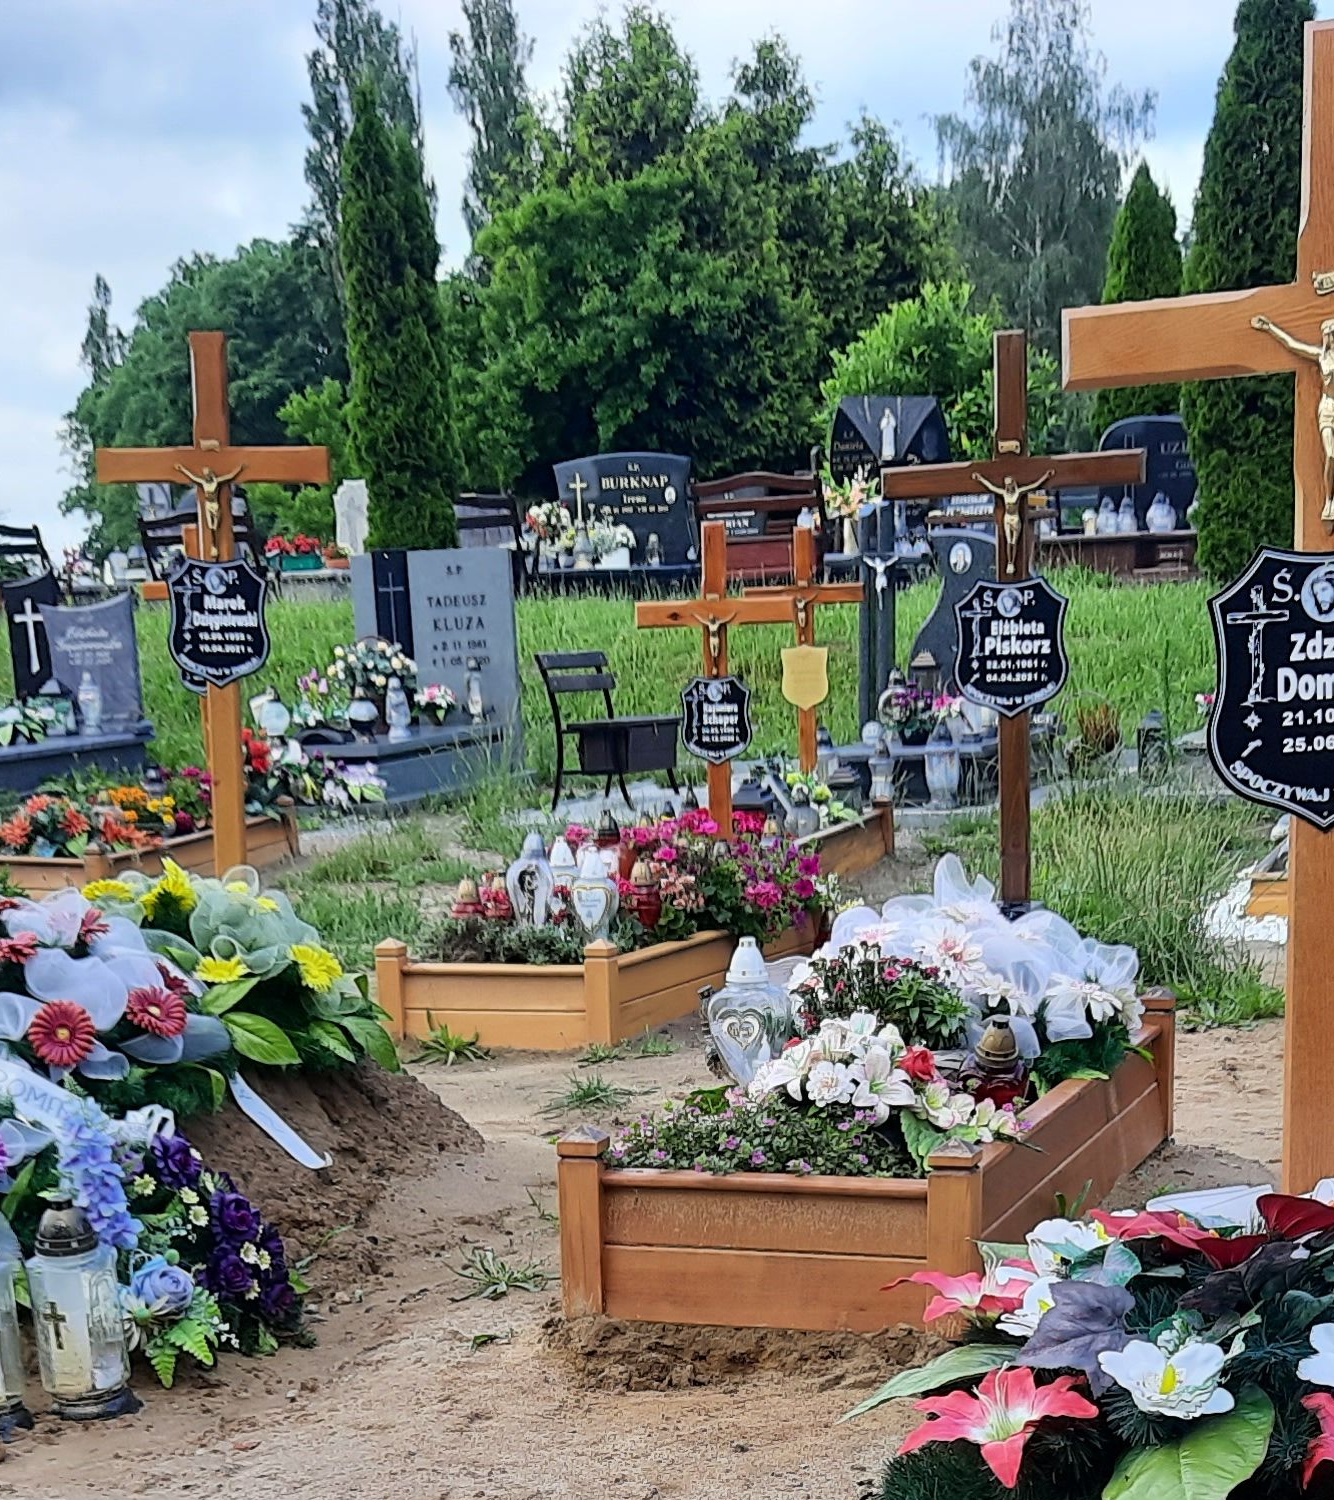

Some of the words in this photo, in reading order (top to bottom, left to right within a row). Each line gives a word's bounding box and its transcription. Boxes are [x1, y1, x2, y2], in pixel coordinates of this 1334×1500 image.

[601, 474, 668, 490] BURKNAP
[1270, 567, 1301, 603] Ś.
[203, 594, 246, 611] Marek
[427, 594, 486, 608] TADEUSZ
[1023, 589, 1036, 606] P.
[433, 616, 485, 632] KLUZA
[990, 618, 1045, 636] Elżbieta
[984, 635, 1052, 656] Piskorz
[1229, 759, 1331, 802] SPOCZYWAJ
